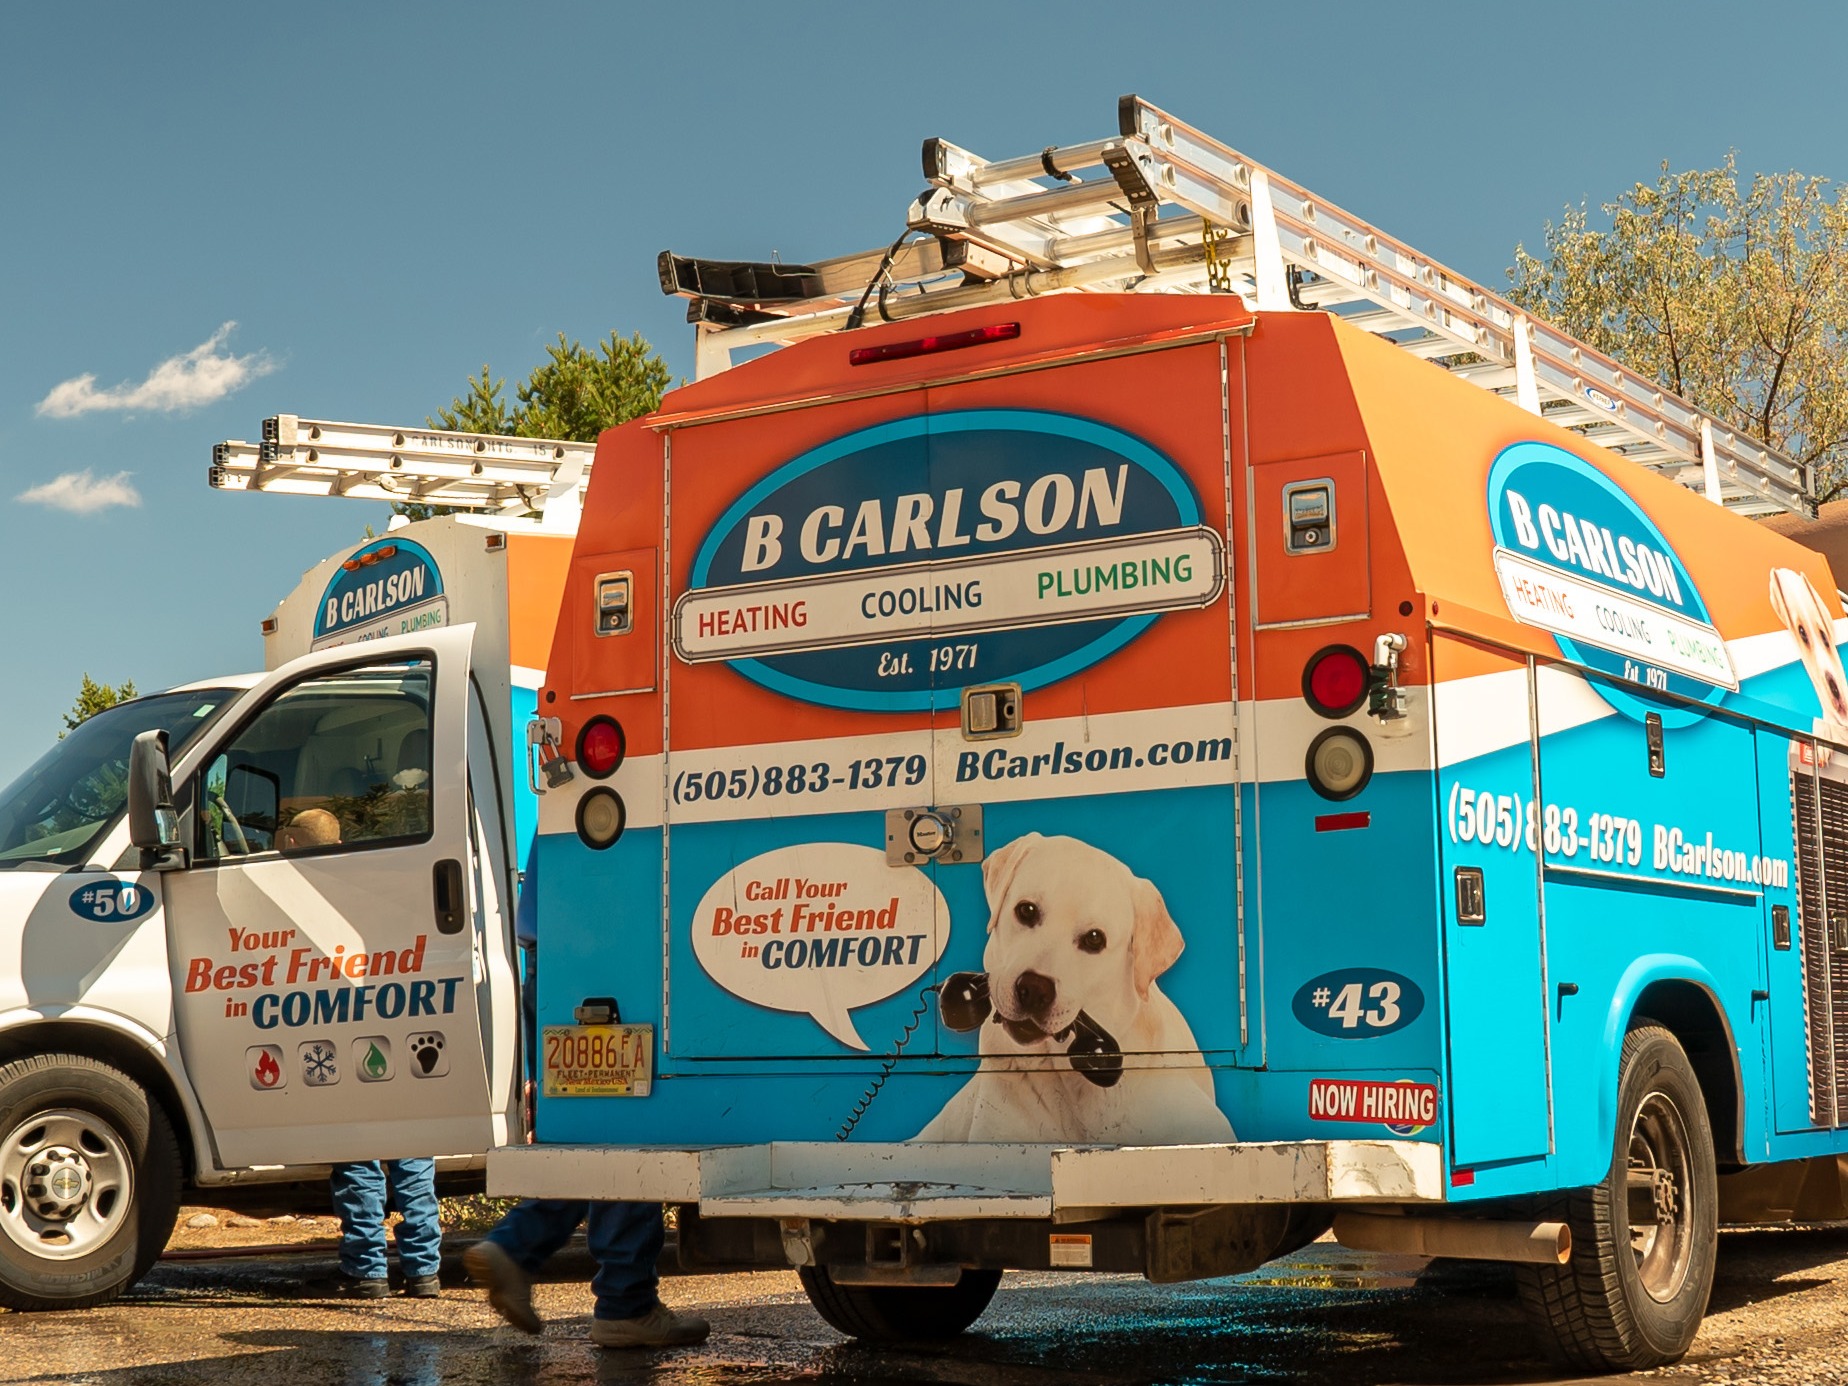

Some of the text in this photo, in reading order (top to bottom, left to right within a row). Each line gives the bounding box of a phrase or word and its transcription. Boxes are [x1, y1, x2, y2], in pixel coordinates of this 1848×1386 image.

[740, 464, 1128, 572] B CARLSON
[1506, 489, 1683, 606] B CARLSON
[326, 564, 425, 628] B CARLSON
[698, 554, 1193, 638] HEATING COOLING PLUMBING
[401, 609, 441, 633] PLUMBING
[1512, 575, 1724, 669] HEATING COOLING PLUMBING
[878, 644, 978, 677] Est. 1971
[1646, 667, 1667, 690] 1971
[673, 737, 1232, 805] (505)883-1379 BCarlson.com
[1448, 781, 1788, 890] (505)883-1379 BCarlson.com
[81, 888, 141, 917] #50
[745, 878, 848, 901] Call Your
[228, 927, 296, 951] Your
[711, 898, 899, 936] Best Friend
[184, 934, 427, 993] Best Friend
[741, 934, 927, 970] in COMFORT
[225, 977, 464, 1029] in COMFORT
[1312, 981, 1401, 1028] #43
[1311, 1084, 1434, 1121] NOW HIRING
